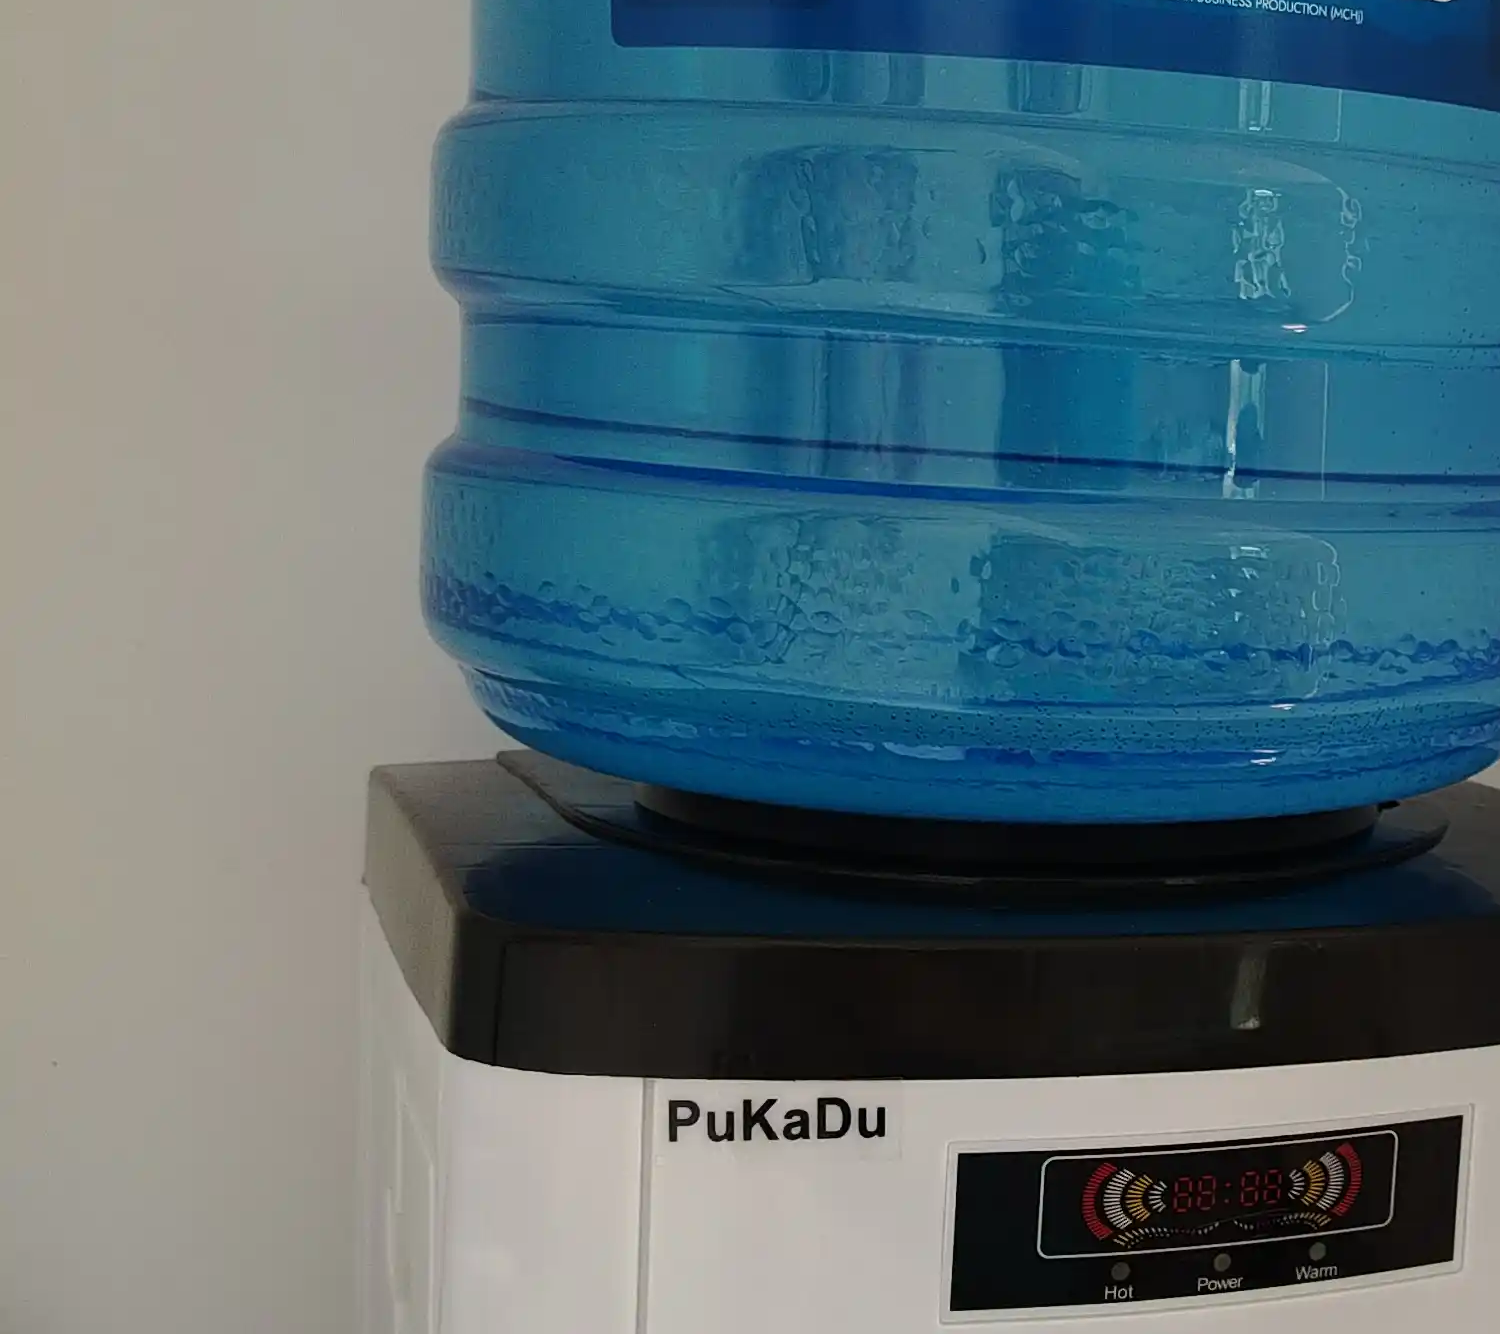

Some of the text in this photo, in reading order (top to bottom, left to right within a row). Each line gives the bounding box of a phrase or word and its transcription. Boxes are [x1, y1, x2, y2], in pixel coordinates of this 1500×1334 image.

[667, 1097, 888, 1143] PuKaDu
[1104, 1264, 1338, 1300] Hot Power Warm
